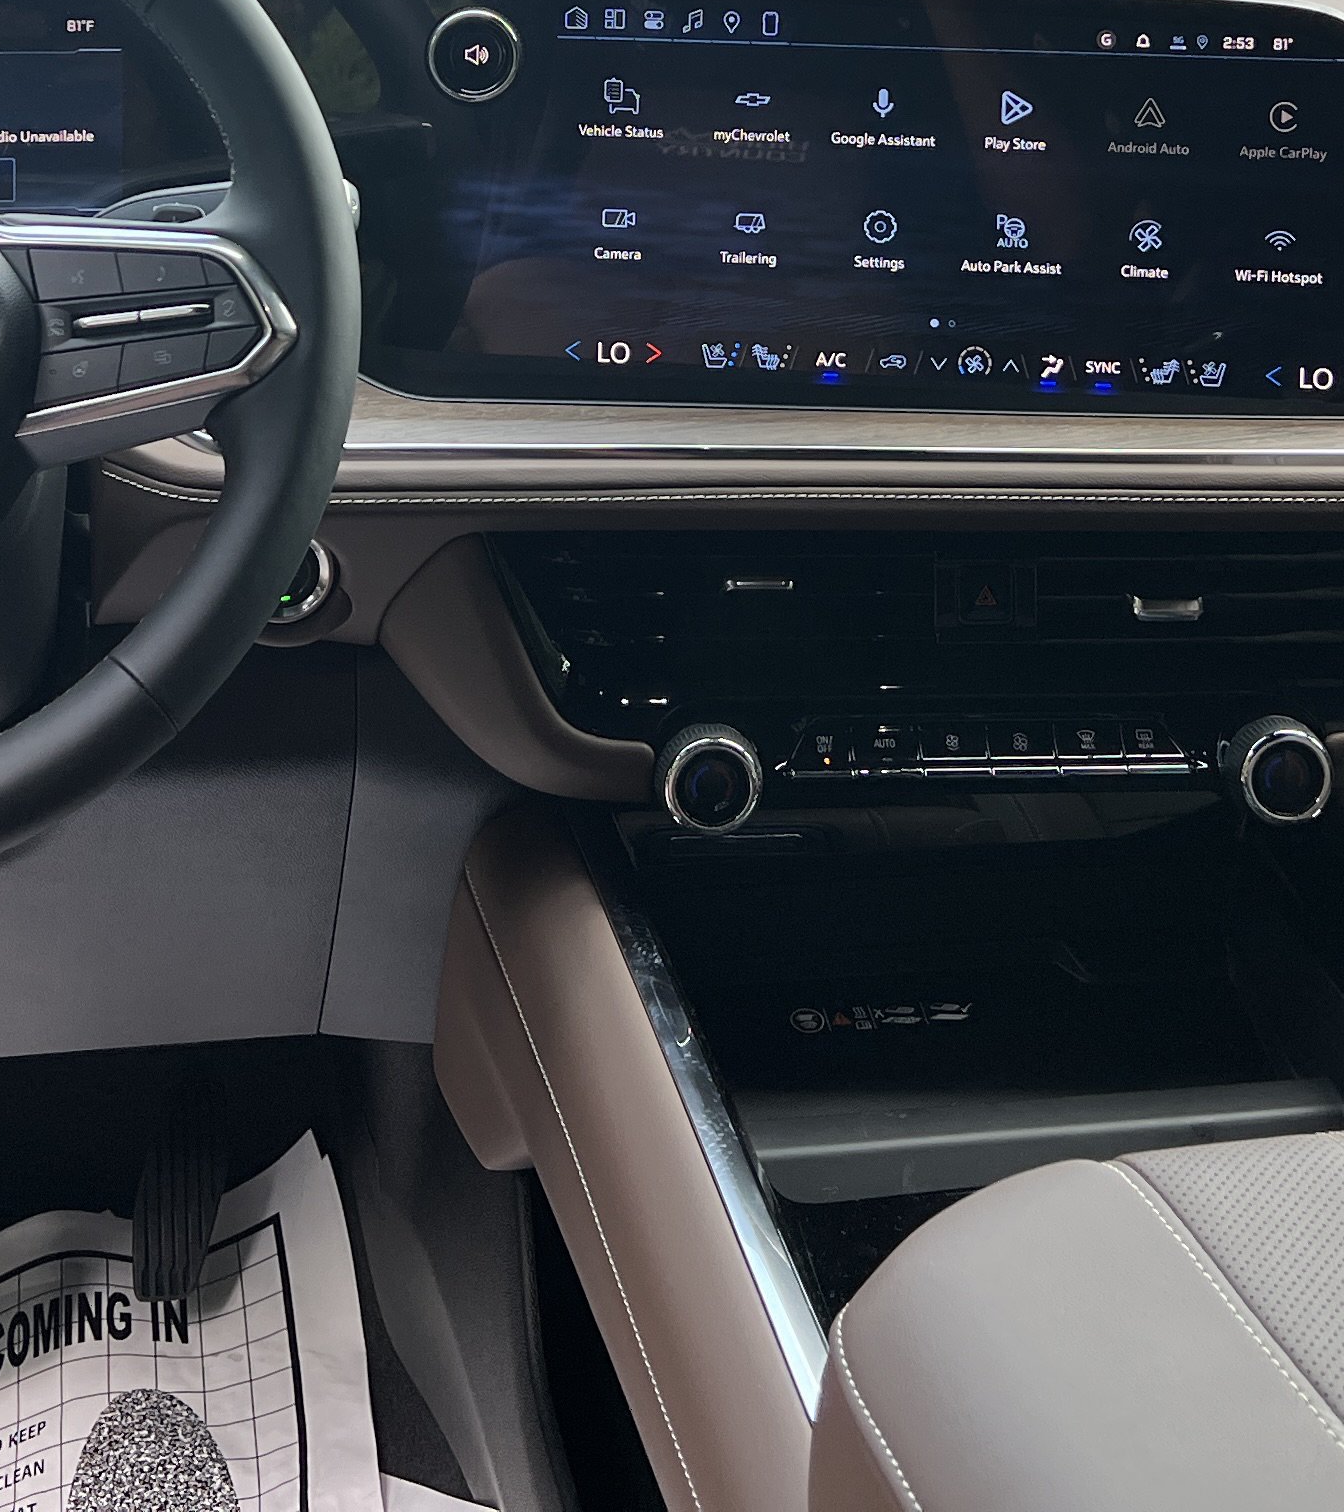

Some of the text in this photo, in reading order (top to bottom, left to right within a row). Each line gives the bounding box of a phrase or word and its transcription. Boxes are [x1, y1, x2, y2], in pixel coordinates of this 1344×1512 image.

[66, 19, 95, 33] 81°F
[1222, 36, 1294, 51] 2:53 81°
[20, 129, 95, 144] Unavailable
[578, 124, 664, 140] Vehicle Status
[713, 128, 791, 145] myChevrolet
[830, 131, 936, 148] Google Assistant
[984, 137, 1047, 153] Play Store
[1107, 141, 1190, 156] Android Auto
[1239, 145, 1328, 163] Apple CarPlay
[593, 247, 642, 262] Camera
[719, 251, 777, 267] Trailering
[853, 256, 905, 271] Settings
[961, 260, 1062, 276] Auto Park Assist
[1120, 265, 1169, 280] Climate
[1235, 268, 1324, 287] Wi-Fi Hotspot
[596, 341, 631, 364] LO
[815, 352, 847, 369] A/C
[1085, 361, 1121, 375] SYNC
[1299, 366, 1334, 390] LO
[817, 745, 833, 754] OFF
[873, 738, 896, 749] AUTO
[151, 1297, 190, 1345] IN
[8, 1420, 47, 1450] KEEP
